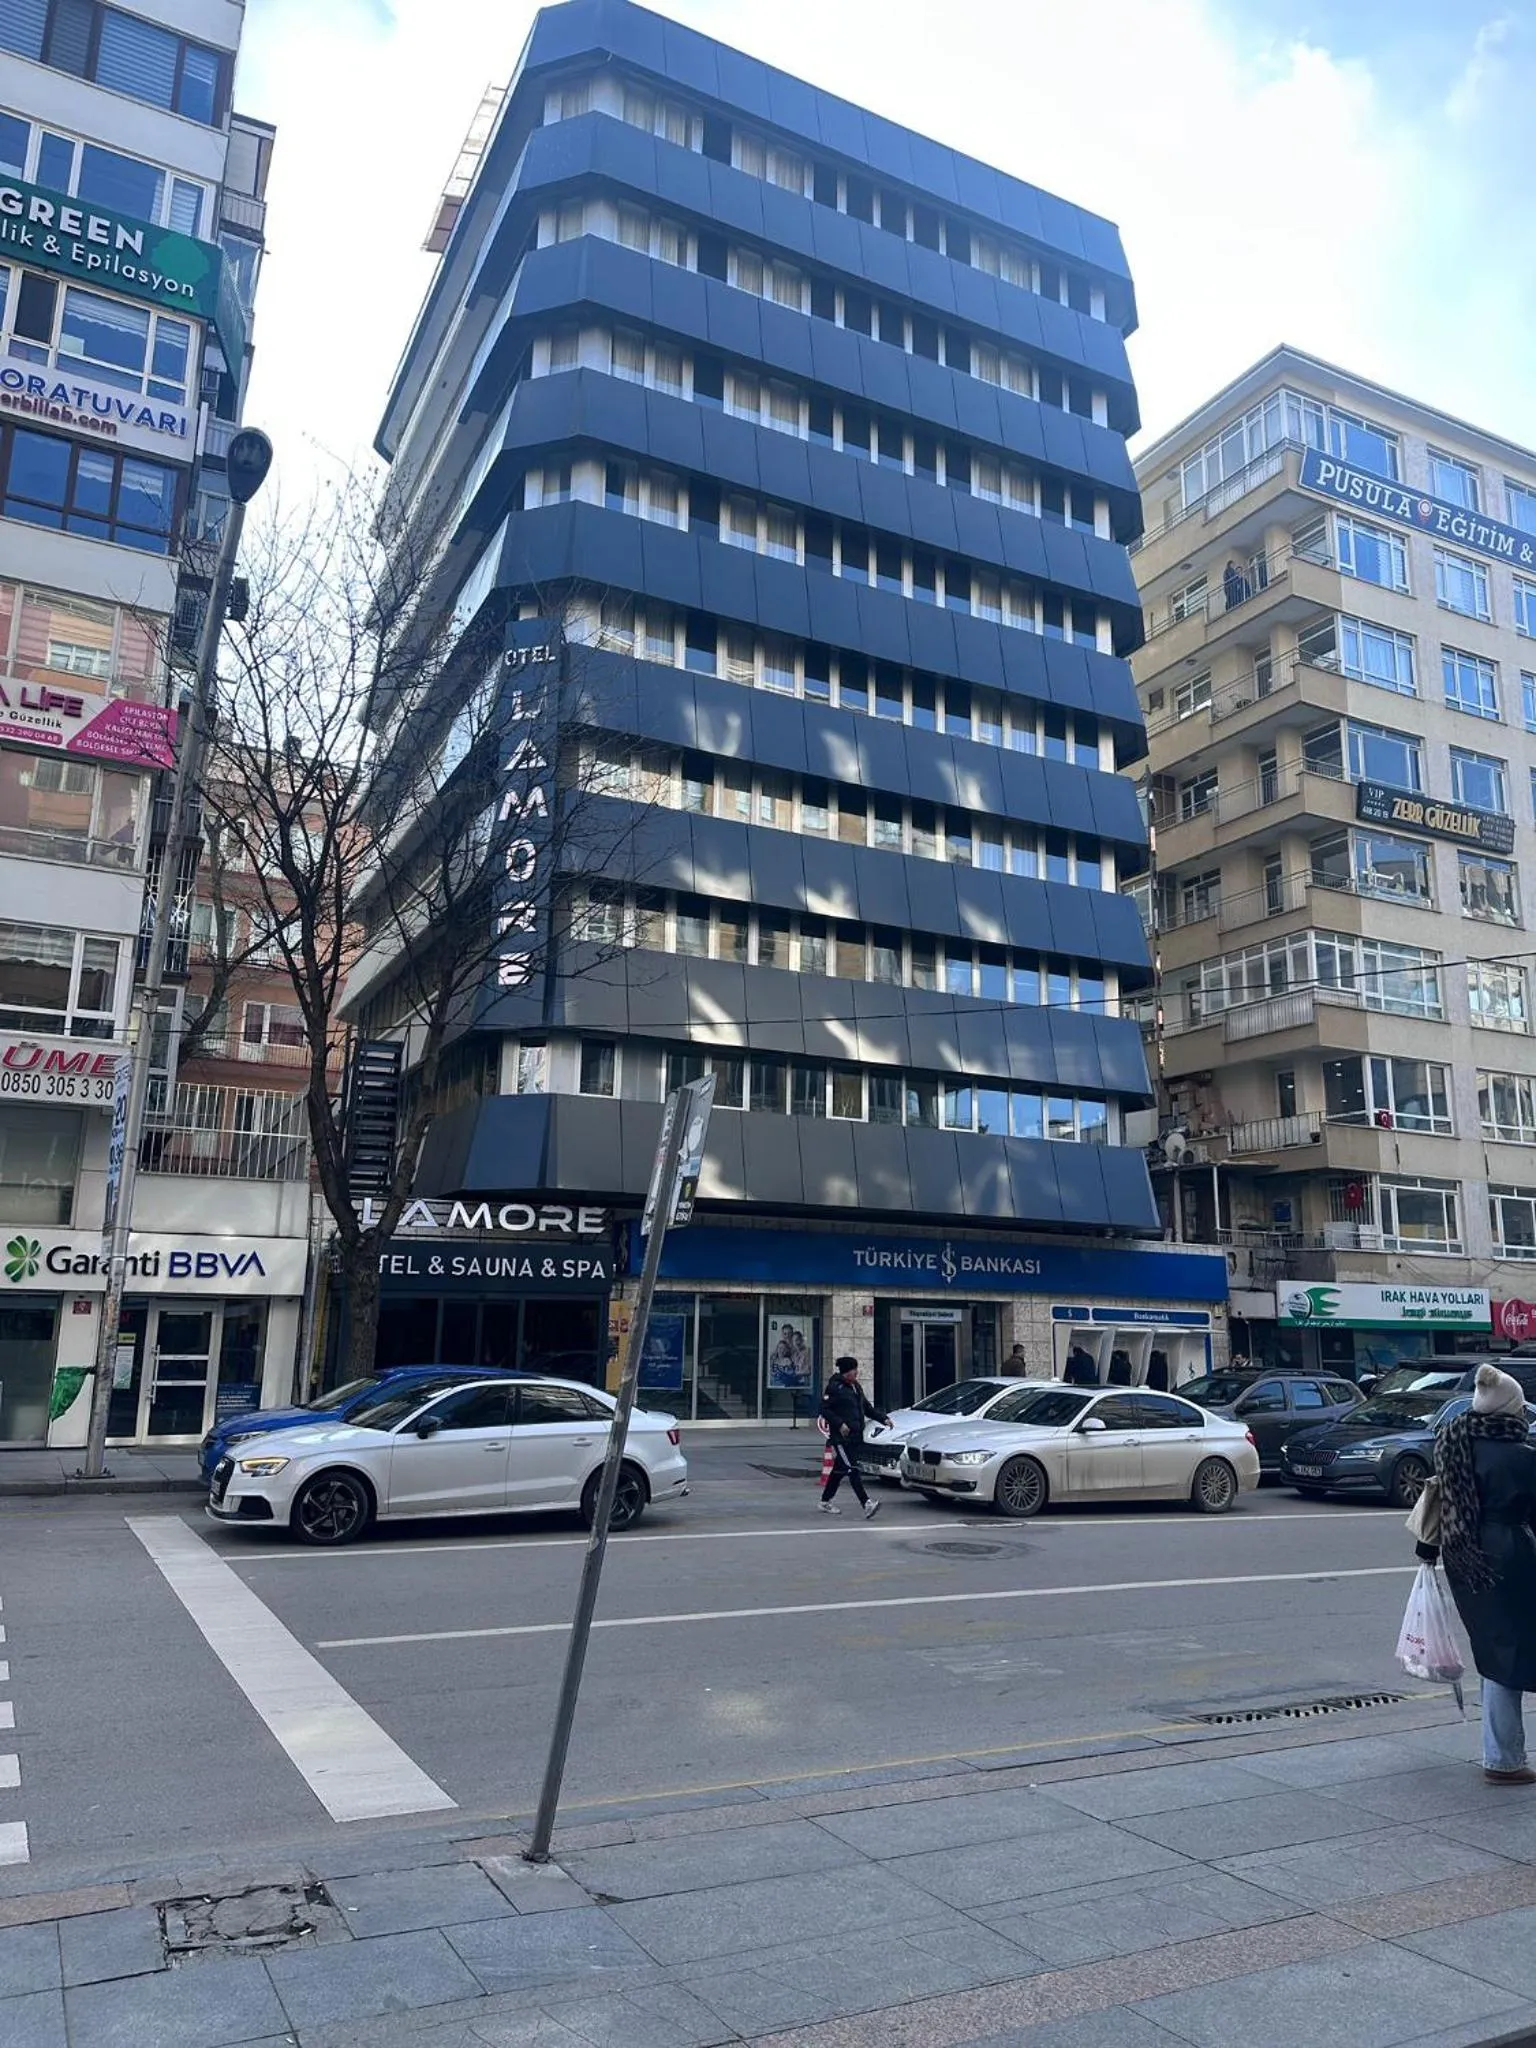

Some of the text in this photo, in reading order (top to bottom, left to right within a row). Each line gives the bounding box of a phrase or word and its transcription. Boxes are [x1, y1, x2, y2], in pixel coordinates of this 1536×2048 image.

[0, 187, 144, 256] GREEN
[2, 218, 195, 298] lik & Epilasyon
[0, 368, 188, 436] ORATUVARI
[1316, 459, 1533, 564] PUSULA EĞİTİM &
[504, 645, 557, 666] OTEL
[1368, 787, 1385, 799] VIP
[1, 1071, 114, 1100] 0850 305 3 30
[362, 1197, 606, 1234] LAMORE
[168, 1250, 266, 1279] BBVA
[428, 1256, 445, 1274] &
[451, 1257, 534, 1278] SAUNA
[540, 1258, 557, 1278] &
[562, 1259, 606, 1279] SPA
[853, 1246, 938, 1269] TÜRKİYE
[961, 1256, 1041, 1275] BANKASI
[1381, 1290, 1485, 1305] IRAK HAVA YOLLARI
